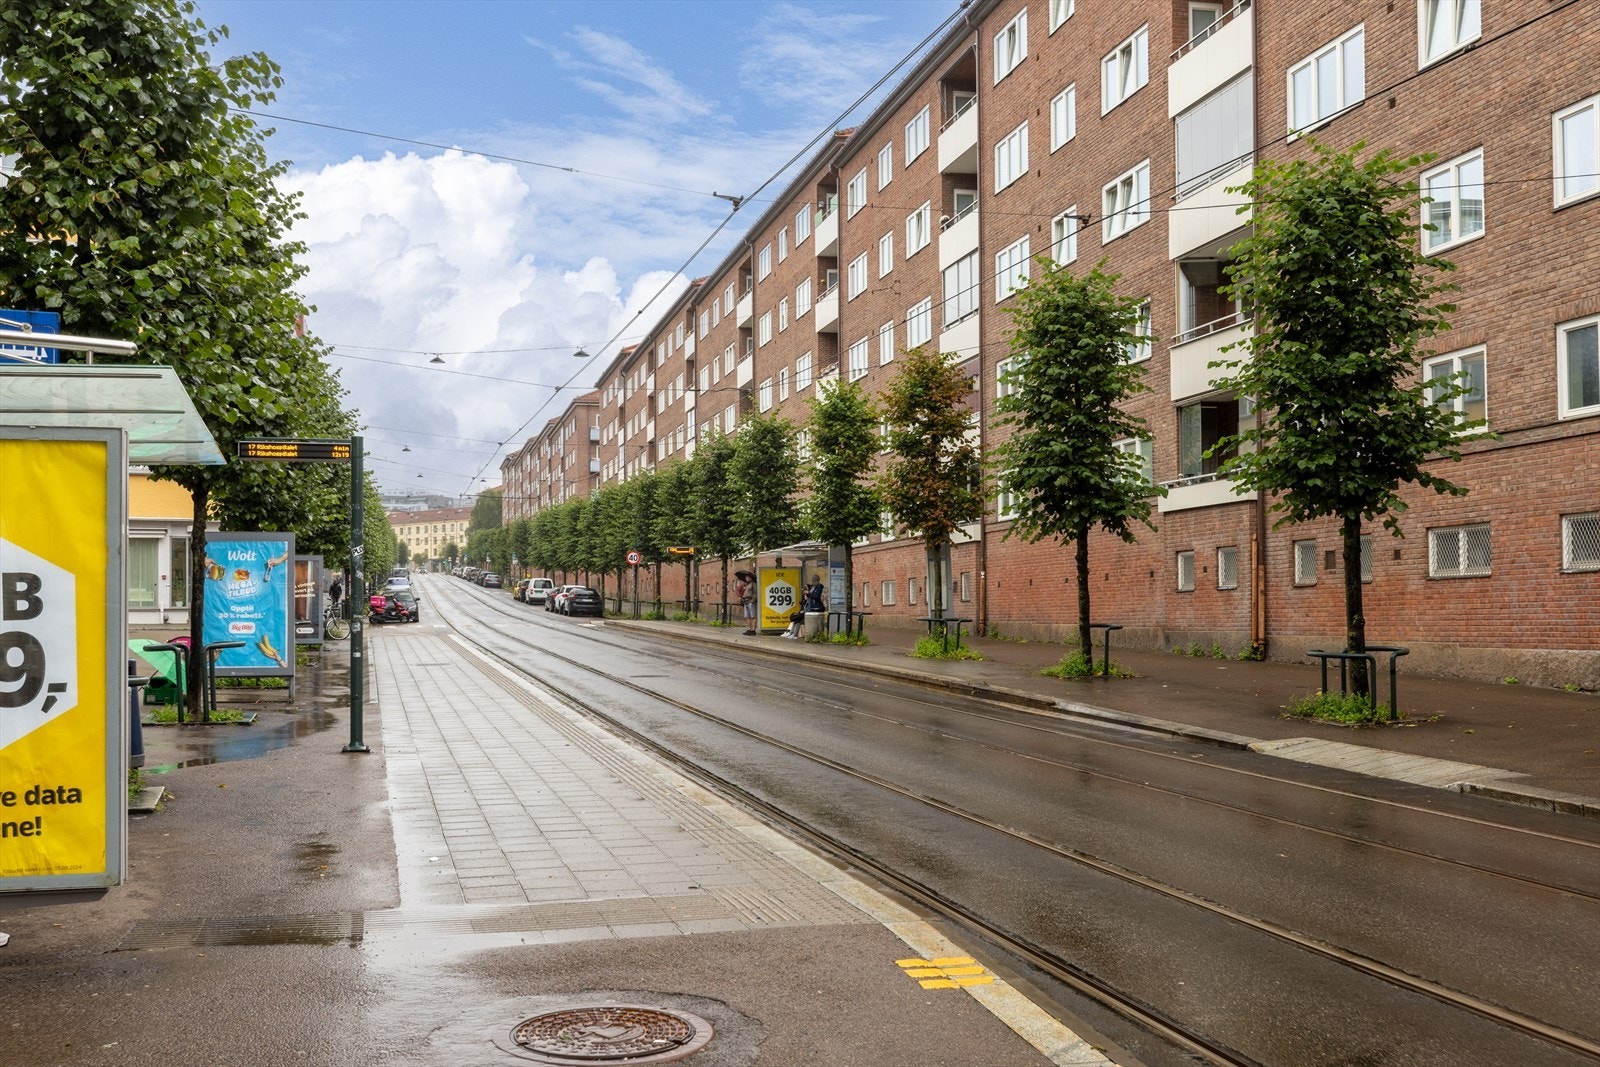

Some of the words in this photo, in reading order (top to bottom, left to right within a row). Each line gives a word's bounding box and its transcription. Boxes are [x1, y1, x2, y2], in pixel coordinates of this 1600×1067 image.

[227, 550, 257, 561] Wolt
[228, 587, 257, 598] TILBUD
[0, 791, 17, 807] e
[24, 784, 82, 806] data
[0, 816, 42, 838] ne!
